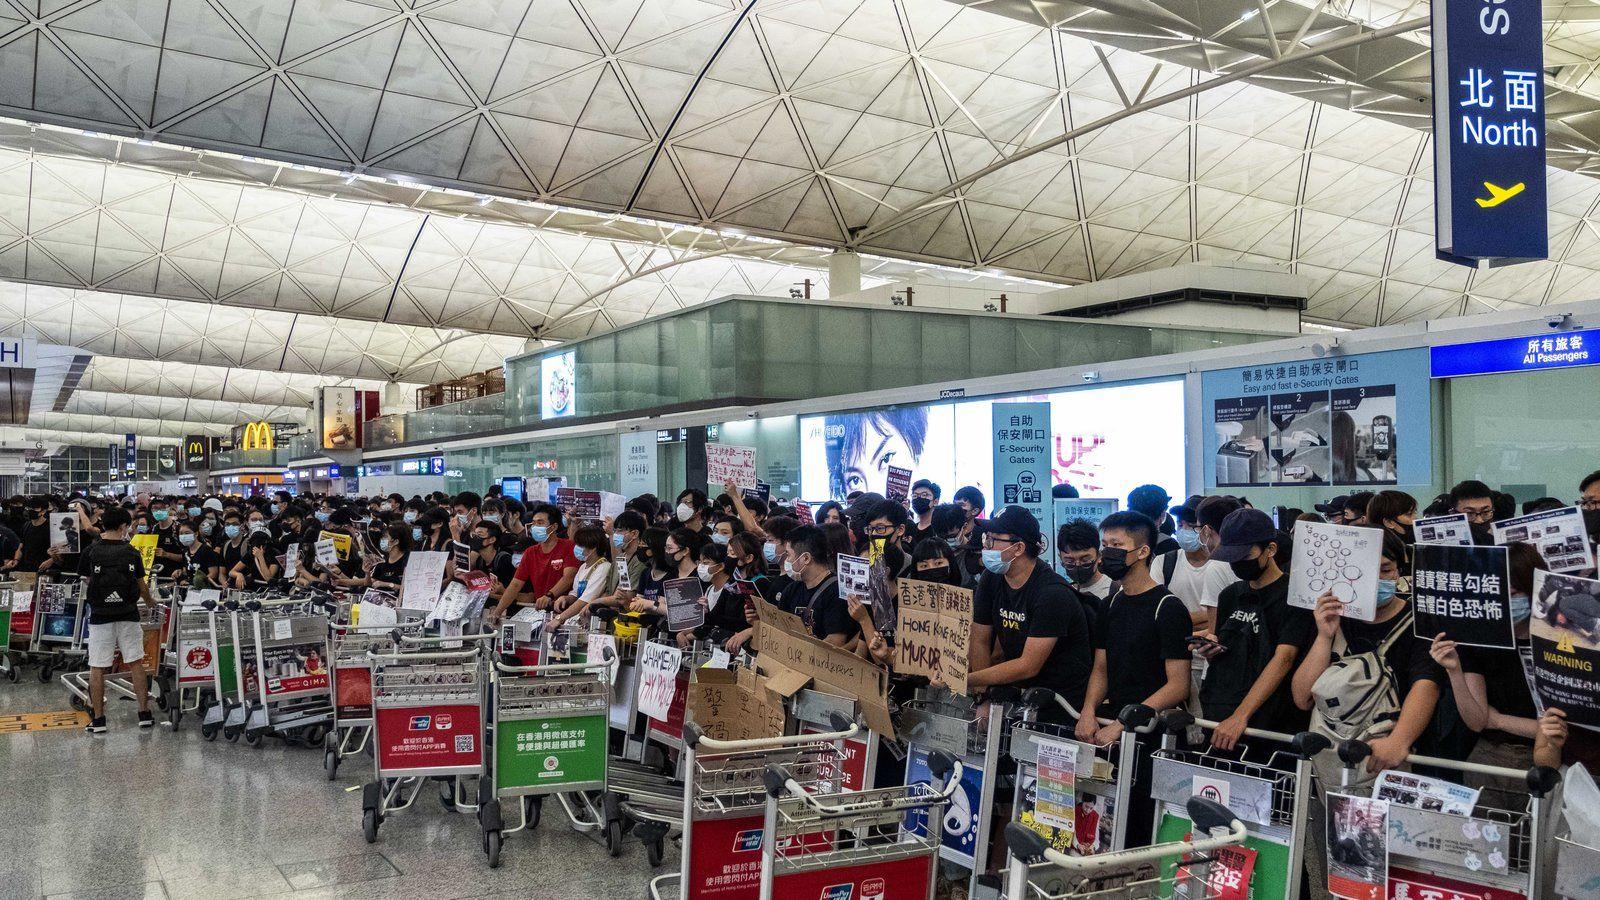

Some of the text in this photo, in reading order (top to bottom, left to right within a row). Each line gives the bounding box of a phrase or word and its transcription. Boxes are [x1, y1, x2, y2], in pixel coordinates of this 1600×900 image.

[1459, 68, 1538, 112] 北面
[1462, 115, 1538, 147] North
[1528, 335, 1582, 353] 所有旅客
[1523, 351, 1589, 364] All Passengers
[1242, 359, 1359, 382] 簡易快捷自助保安閘口
[1243, 375, 1359, 393] Easy and fast e-Security Gates
[1296, 393, 1301, 402] 2
[1359, 388, 1365, 397] 3
[1239, 398, 1243, 406] 1
[1010, 414, 1033, 427] 自助
[997, 429, 1045, 441] 保安閘口
[36, 440, 43, 450] G
[999, 444, 1045, 454] E-Security
[1009, 455, 1035, 464] Gates
[1416, 593, 1503, 620] 無懼白色恐怖
[902, 616, 930, 636] HONG
[933, 621, 948, 639] KONG
[1543, 650, 1593, 672] WARNING
[303, 678, 326, 687] QIMA
[516, 729, 586, 742] 在香港用微信支付
